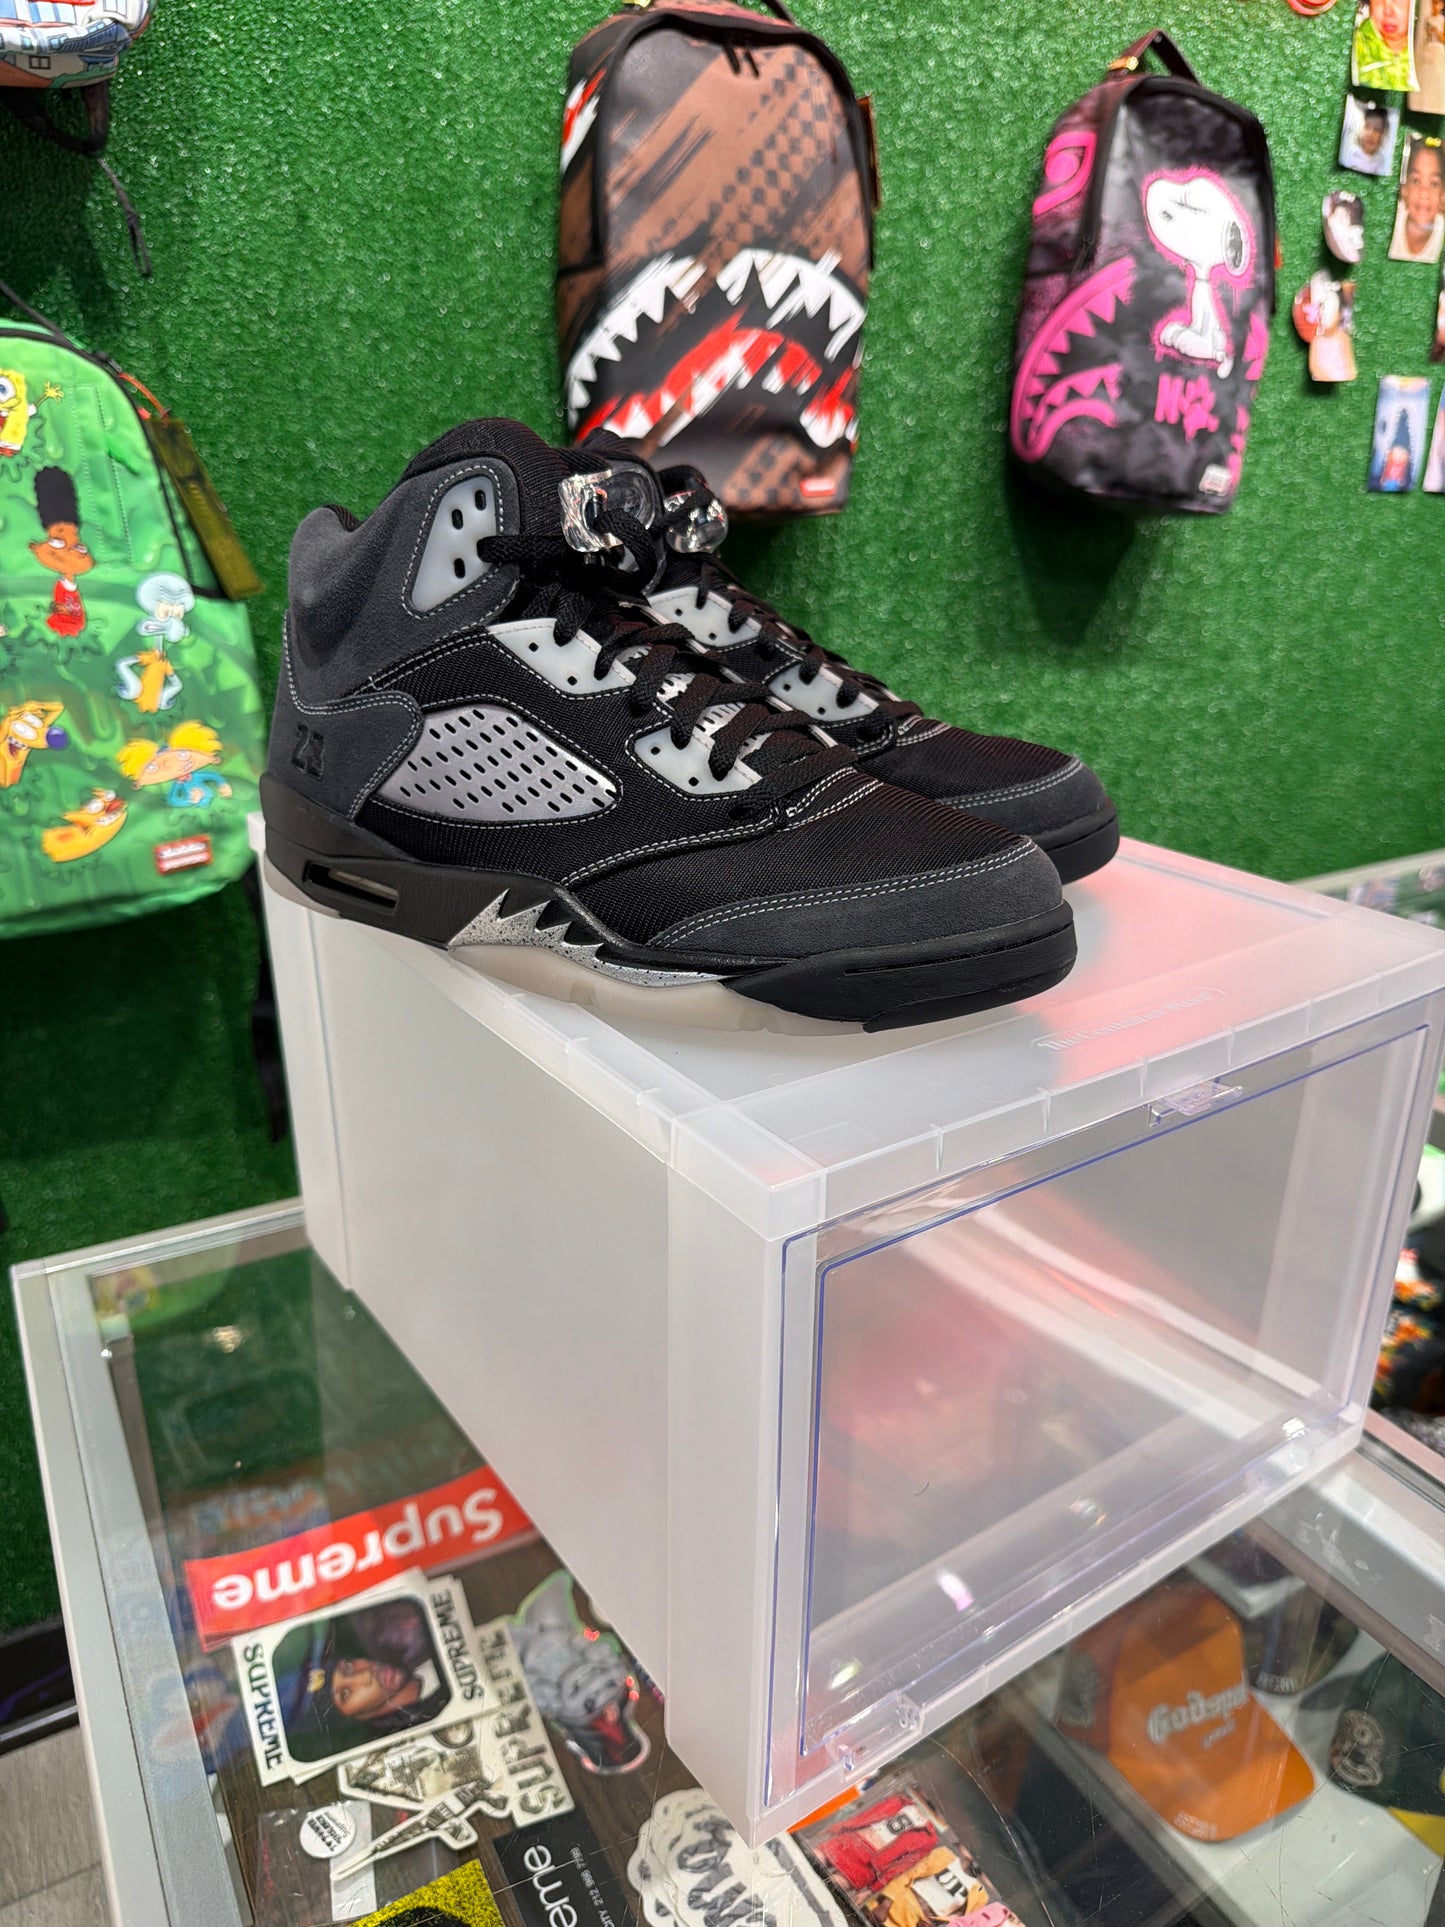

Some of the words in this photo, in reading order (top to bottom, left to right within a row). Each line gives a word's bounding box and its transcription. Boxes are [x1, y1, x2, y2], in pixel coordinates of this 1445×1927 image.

[291, 724, 324, 778] 23
[213, 1488, 504, 1610] Supreme
[432, 1589, 484, 1701] SUPREME
[243, 1643, 283, 1770] SUPREME
[934, 1867, 968, 1897] UP
